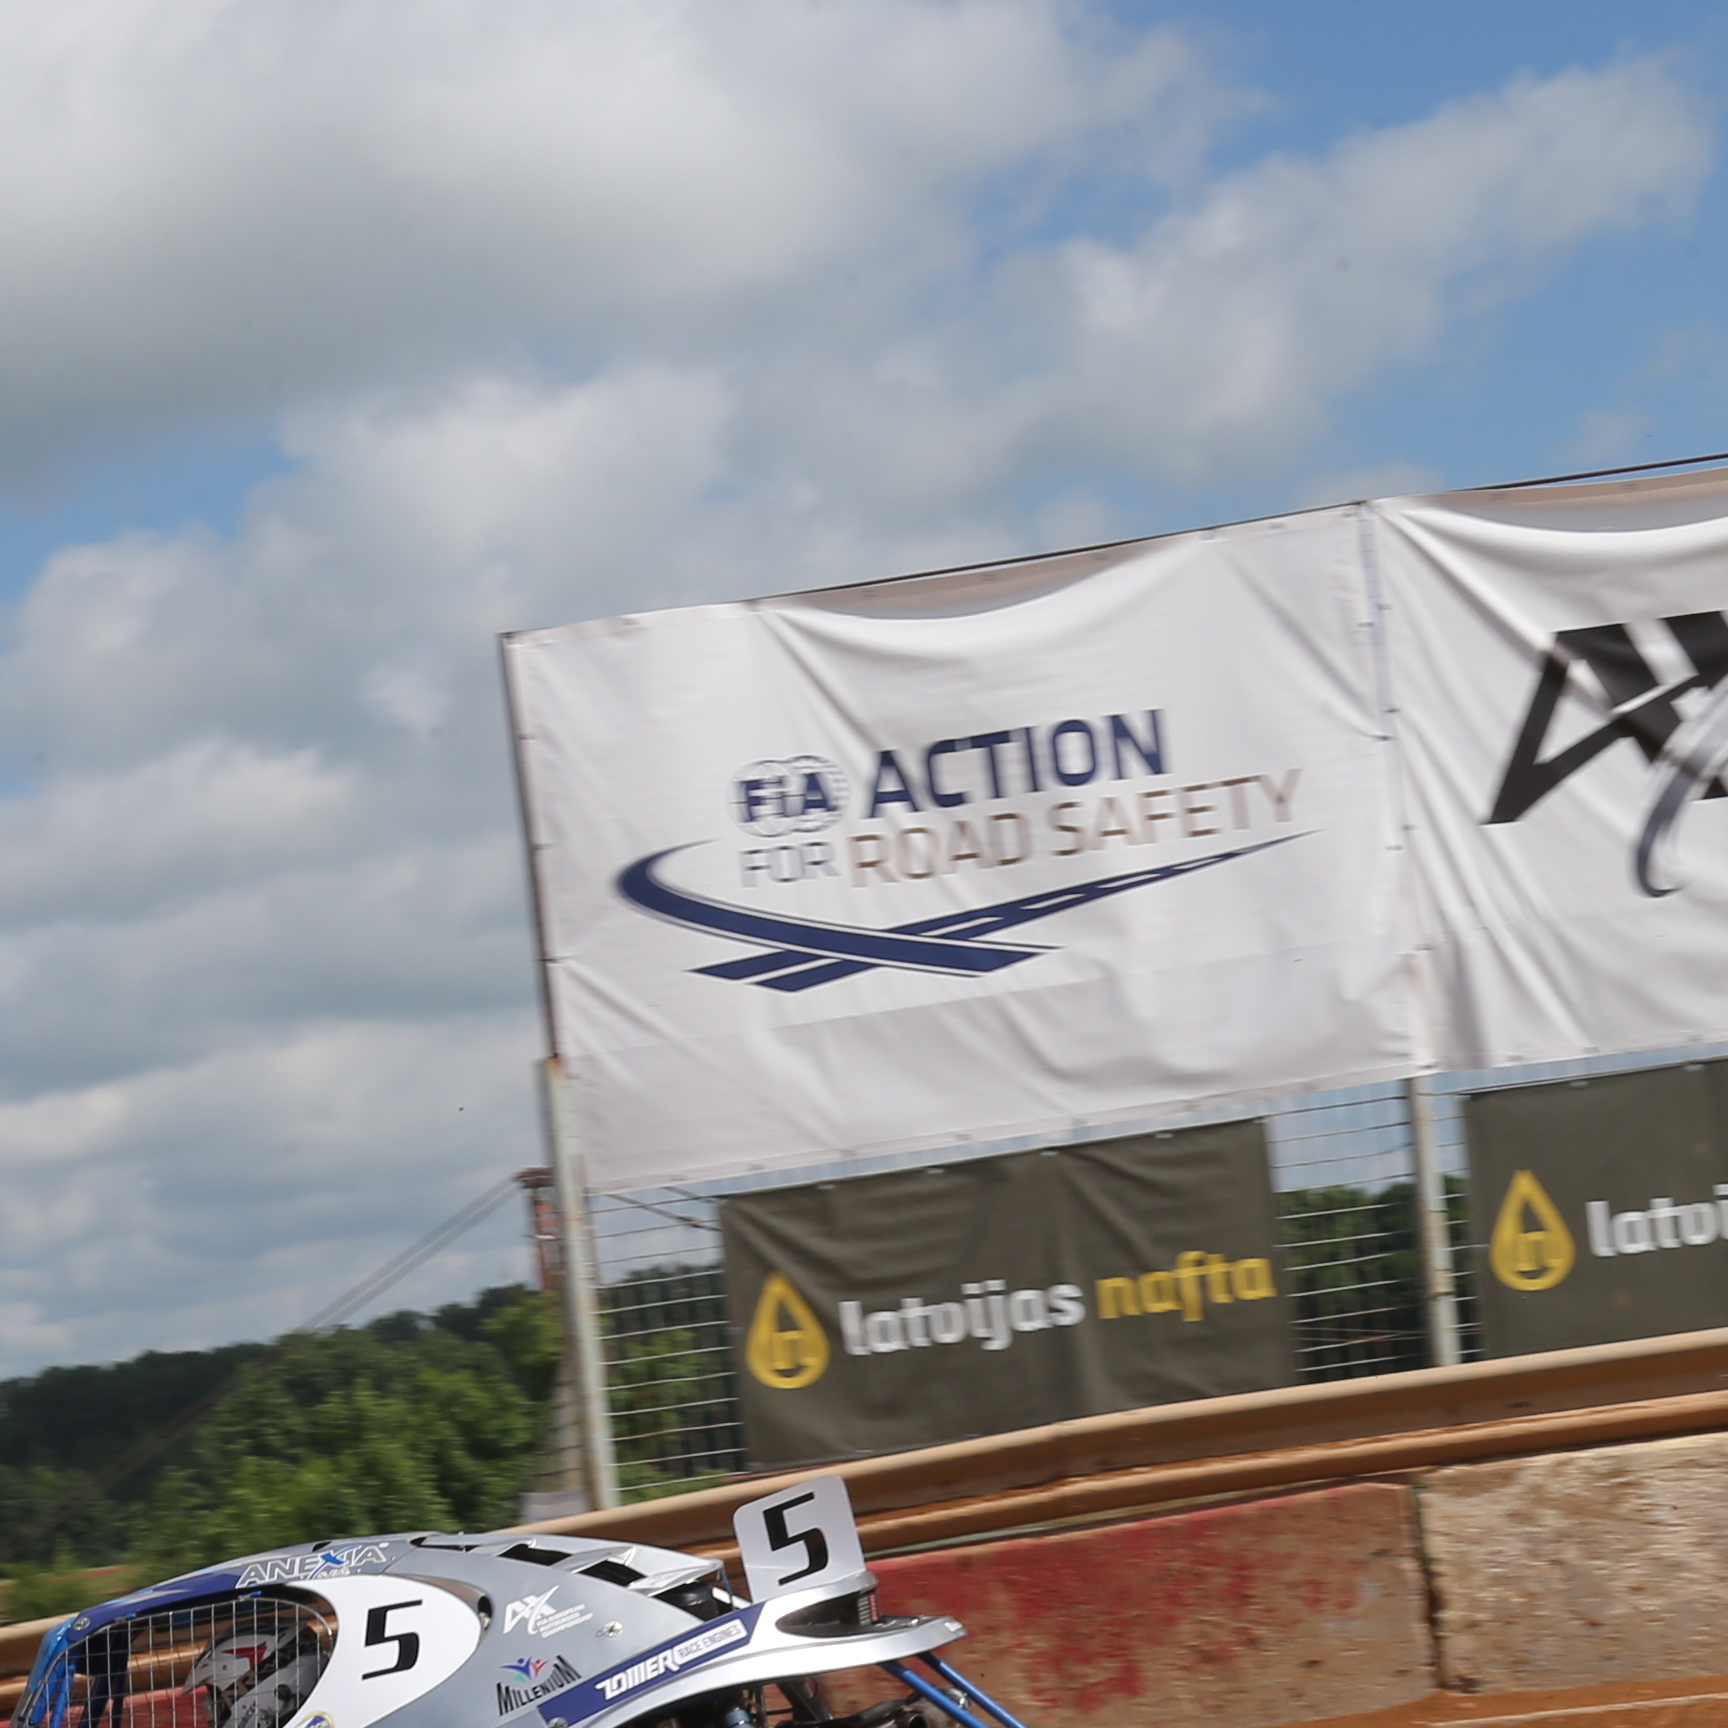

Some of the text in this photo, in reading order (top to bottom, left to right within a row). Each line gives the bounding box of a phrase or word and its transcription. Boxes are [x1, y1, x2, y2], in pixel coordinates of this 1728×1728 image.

[868, 709, 1169, 818] ACTION
[739, 769, 1301, 888] FOR ROAD SAFETY
[1096, 1250, 1276, 1322] nafta
[235, 1545, 386, 1588] ANEXIA
[763, 1491, 829, 1586] 5
[362, 1599, 423, 1680] 5
